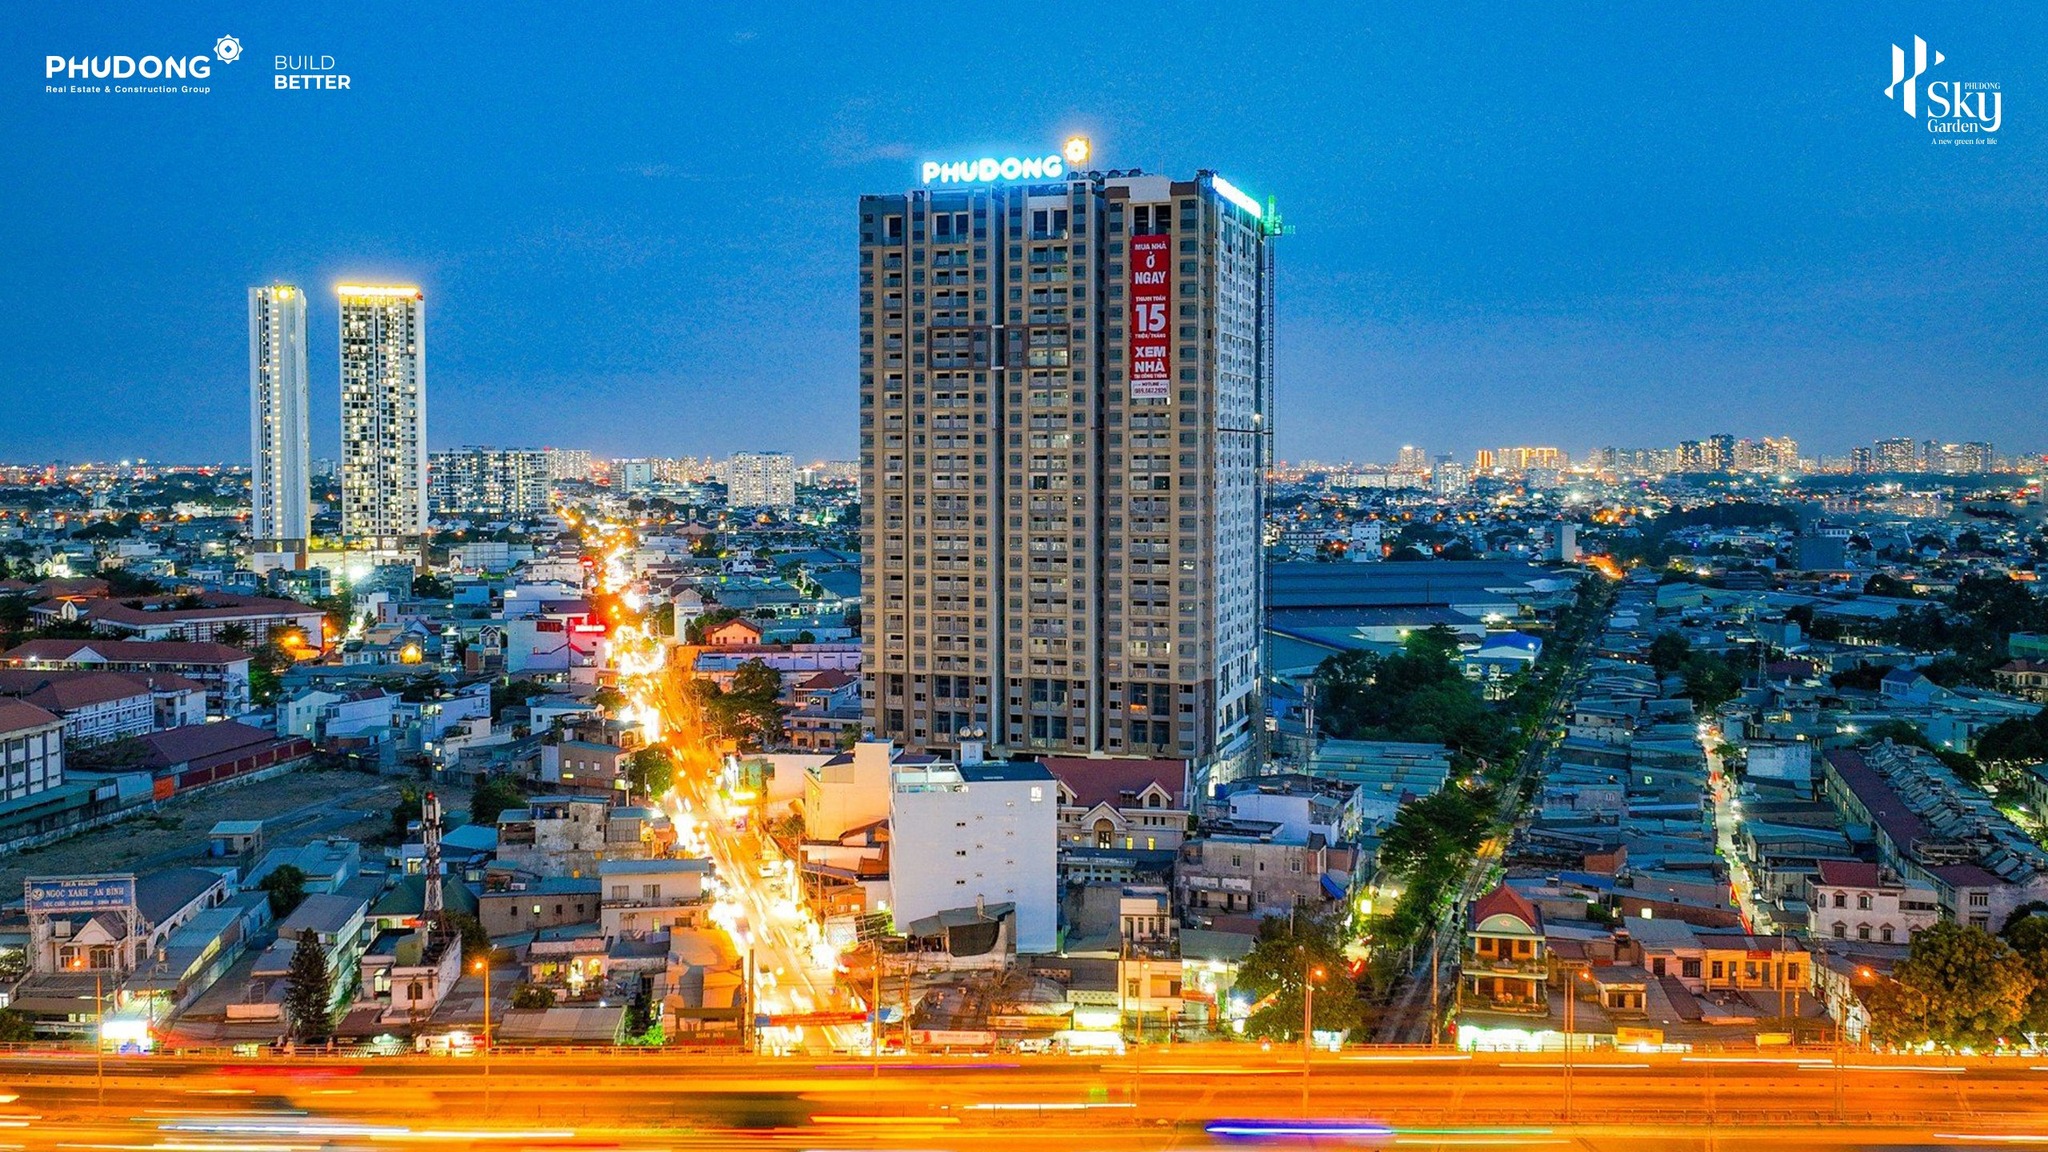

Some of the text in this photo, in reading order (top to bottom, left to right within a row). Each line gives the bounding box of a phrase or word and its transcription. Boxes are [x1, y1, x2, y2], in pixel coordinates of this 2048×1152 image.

[922, 154, 1063, 184] PHUDONG
[1146, 251, 1156, 269] Ở
[1135, 271, 1166, 285] NGAY
[1135, 303, 1166, 332] 15
[1135, 346, 1166, 358] XEM
[1134, 358, 1166, 373] NHÀ
[68, 888, 88, 898] XANH
[93, 887, 104, 897] AN
